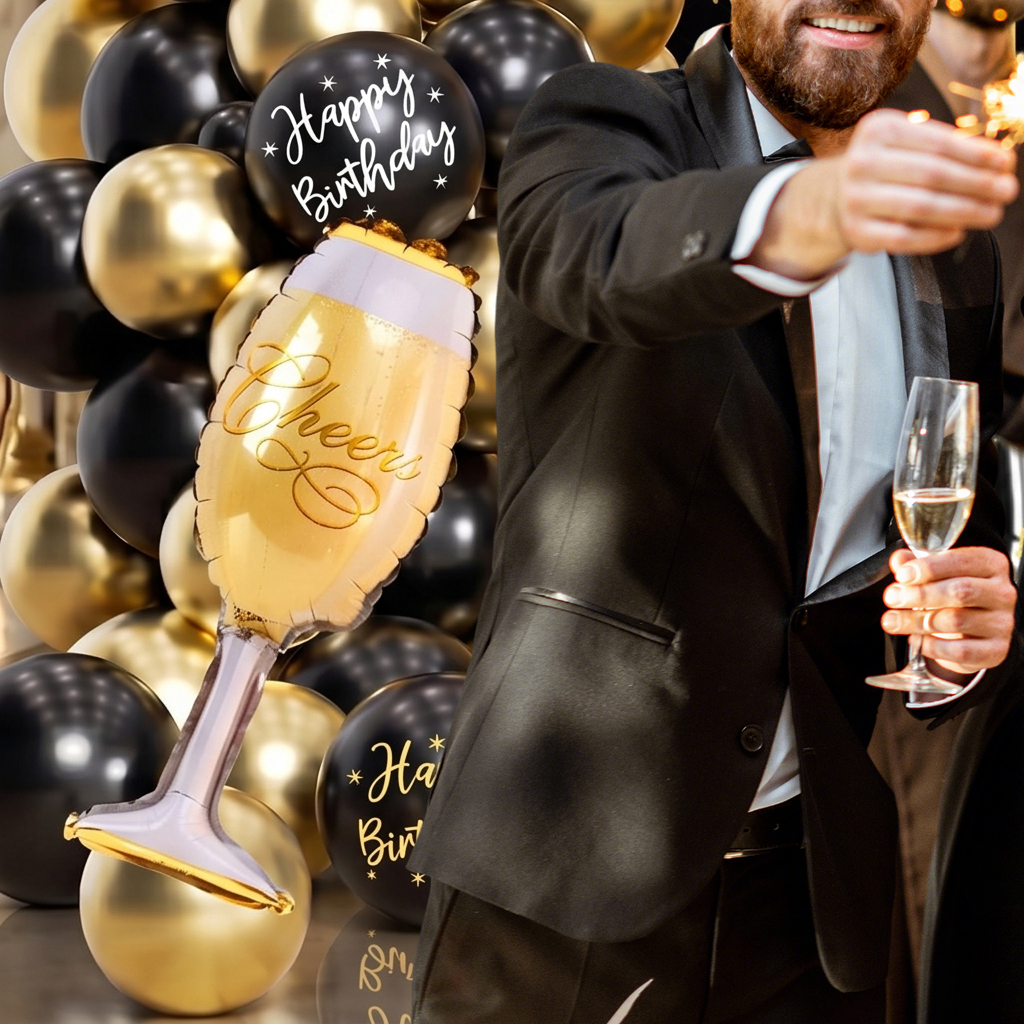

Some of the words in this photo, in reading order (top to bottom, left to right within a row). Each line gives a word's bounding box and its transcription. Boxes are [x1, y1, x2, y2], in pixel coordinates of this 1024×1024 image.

[270, 68, 415, 165] Happy
[291, 121, 456, 222] Birthday
[222, 342, 423, 481] Cheers
